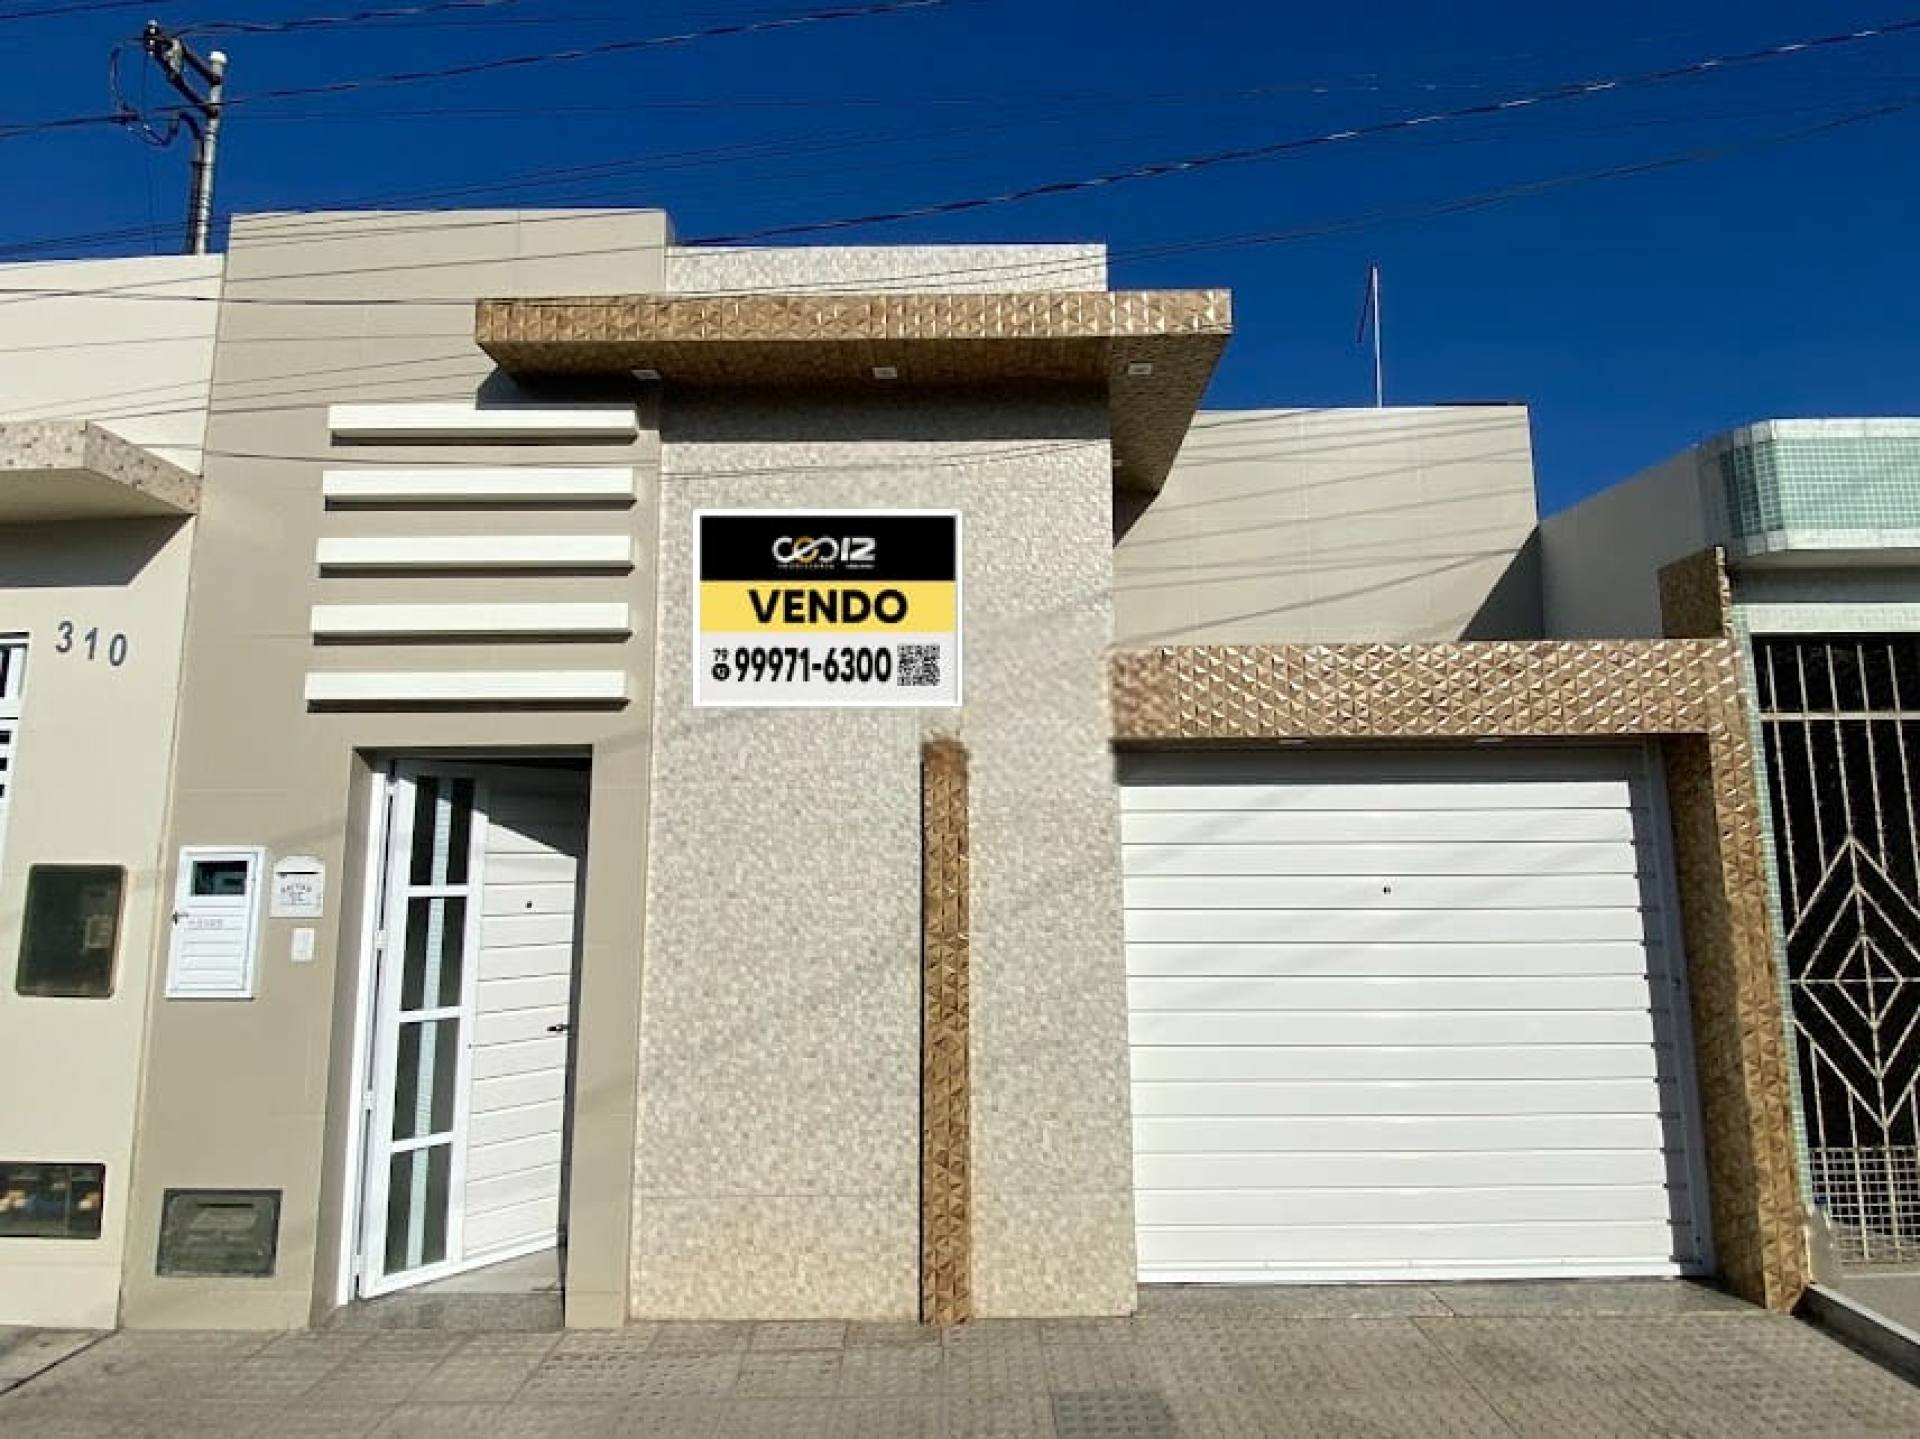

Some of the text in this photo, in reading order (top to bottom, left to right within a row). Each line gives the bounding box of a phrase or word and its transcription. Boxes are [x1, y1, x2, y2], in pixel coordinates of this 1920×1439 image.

[748, 588, 907, 624] VENDO
[55, 620, 128, 666] 310
[735, 646, 892, 682] 99971-6300
